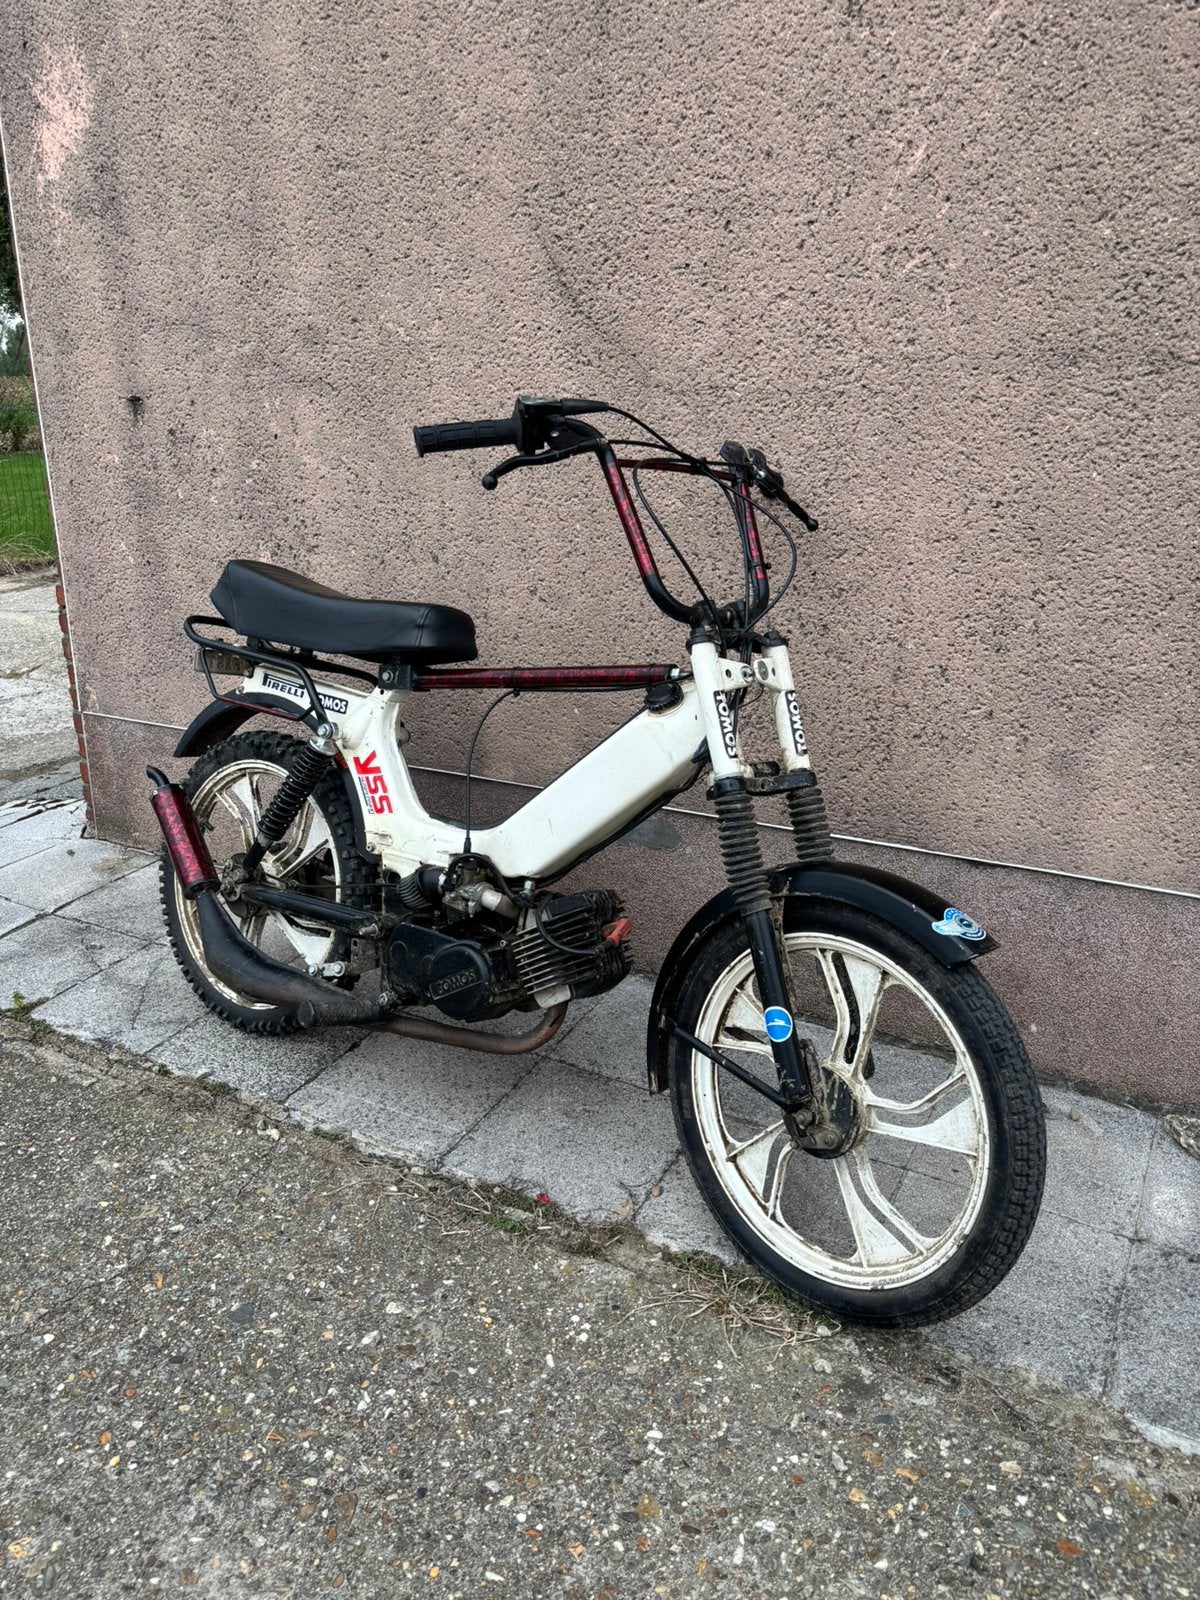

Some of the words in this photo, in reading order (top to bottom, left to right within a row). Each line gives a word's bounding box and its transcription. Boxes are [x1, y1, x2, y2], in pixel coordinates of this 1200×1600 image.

[262, 673, 306, 698] PIRELLI
[318, 695, 346, 713] OMOS
[716, 691, 736, 756] TOMOS
[786, 691, 807, 753] TOMOS
[353, 750, 393, 814] YSS
